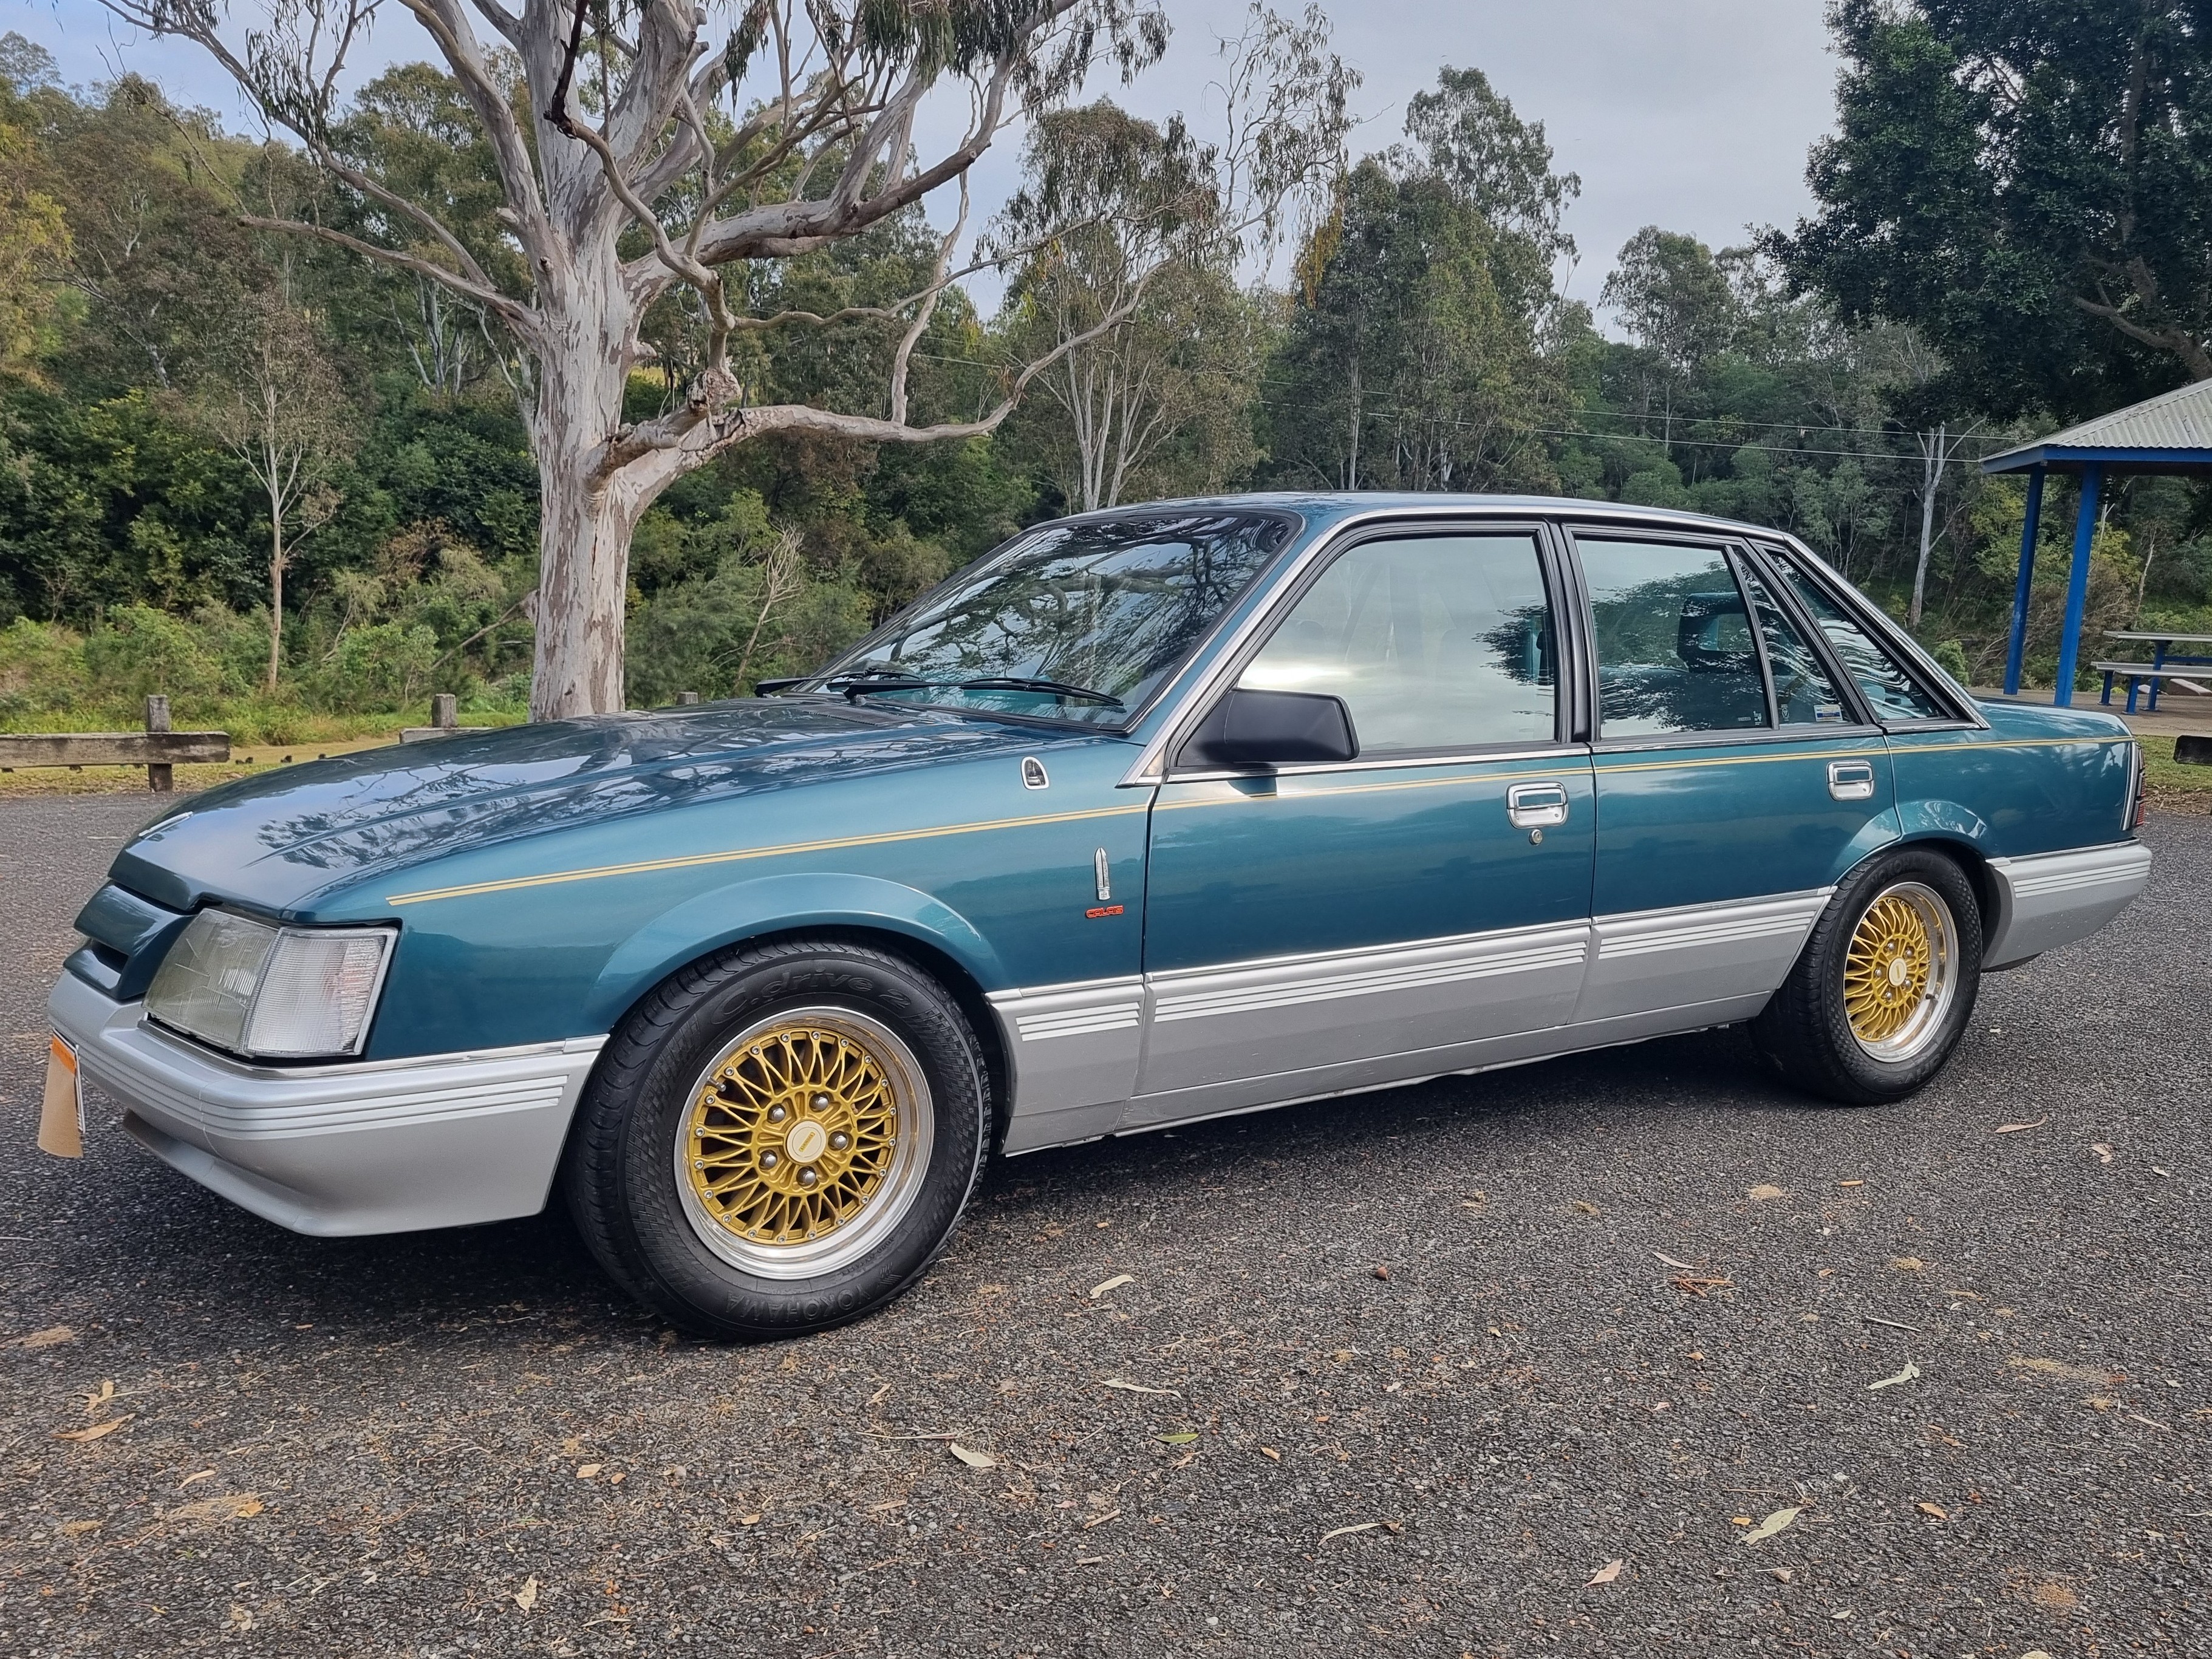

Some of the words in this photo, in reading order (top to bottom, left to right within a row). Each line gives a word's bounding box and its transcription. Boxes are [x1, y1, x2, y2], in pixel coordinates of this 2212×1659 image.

[1871, 854, 1934, 884] YOKOH
[1086, 905, 1123, 918] CALAIS
[711, 966, 874, 1025] C.drive
[878, 988, 912, 1009] 2
[726, 1283, 872, 1322] YOKOHAMA
